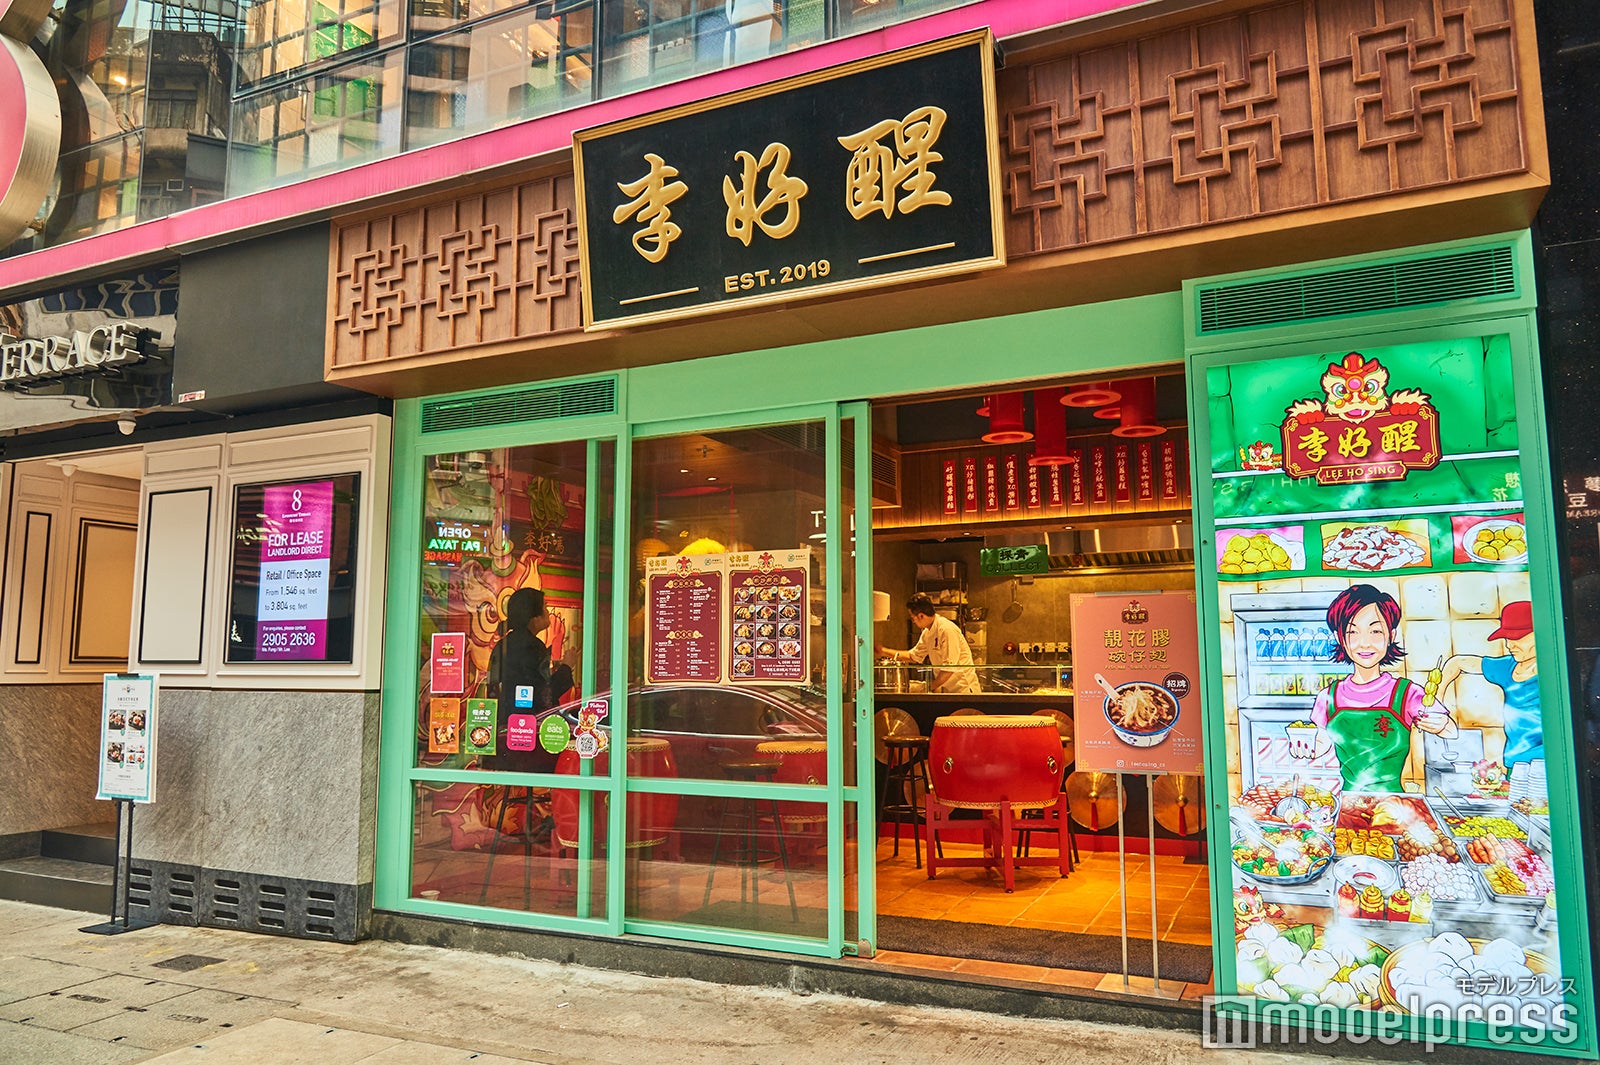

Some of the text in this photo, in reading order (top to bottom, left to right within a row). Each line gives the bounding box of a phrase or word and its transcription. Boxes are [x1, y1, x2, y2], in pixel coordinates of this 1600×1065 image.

[613, 106, 952, 263] 李好醒
[779, 259, 831, 283] 2019
[0, 322, 127, 381] ERRACE
[1298, 420, 1421, 462] 李好醒
[1325, 465, 1396, 479] LEE HO SING
[291, 489, 302, 511] 8
[268, 530, 324, 547] FOR LEASE
[267, 545, 322, 557] LANDLORD DIRECT
[266, 570, 283, 581] Retail
[286, 569, 302, 580] Office
[304, 568, 322, 581] Space
[986, 562, 1041, 573] COLLECT
[265, 588, 280, 596] From
[307, 587, 318, 595] feet
[270, 601, 289, 611] 3,804
[262, 632, 316, 646] 2905 2636
[1104, 628, 1170, 648] 靚花膠
[1108, 649, 1167, 662] 碗仔翅
[1166, 679, 1187, 688] 招牌
[546, 726, 563, 734] eats
